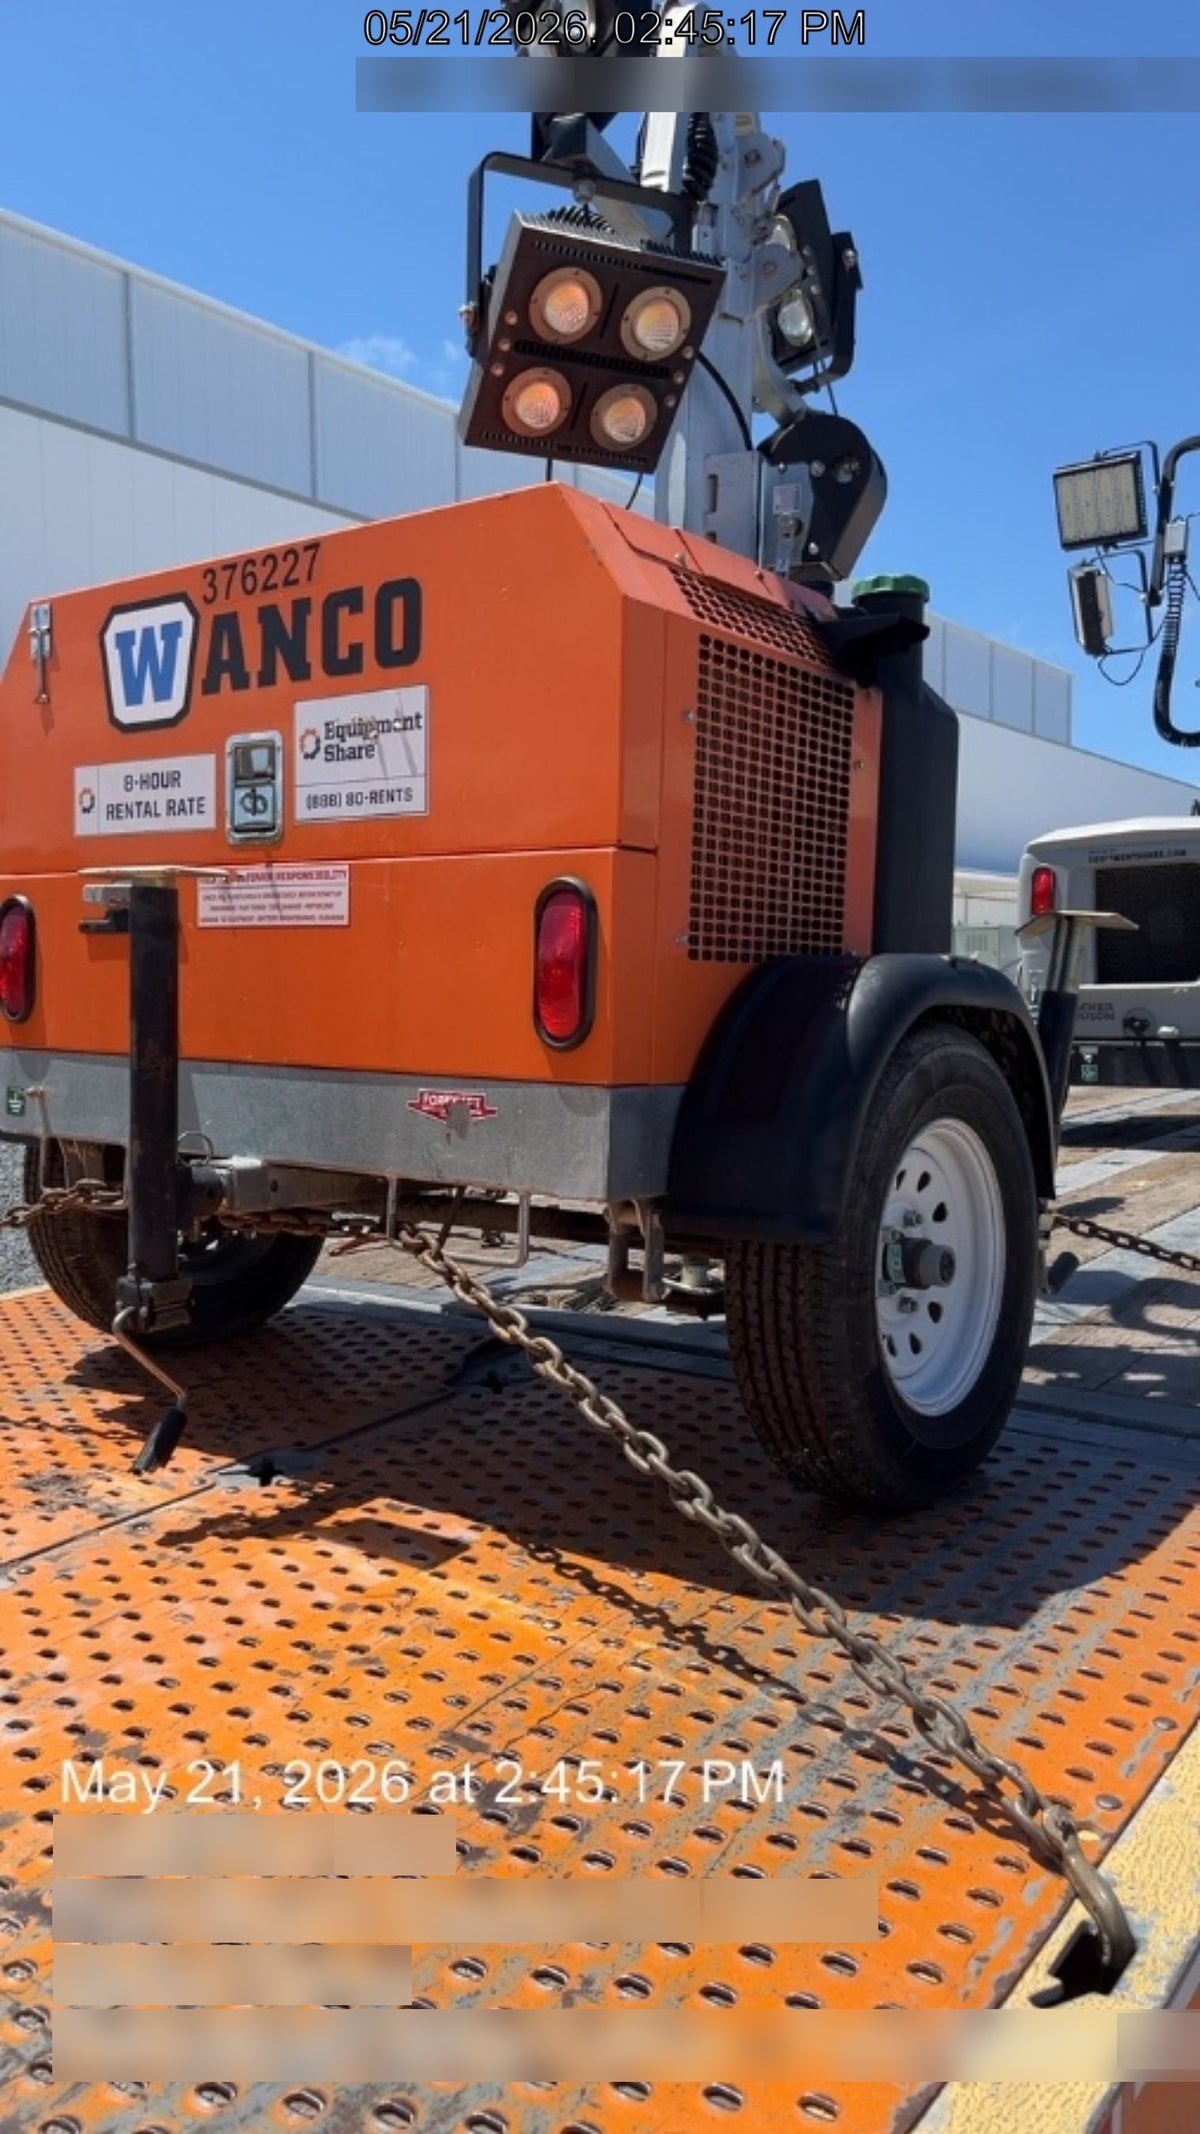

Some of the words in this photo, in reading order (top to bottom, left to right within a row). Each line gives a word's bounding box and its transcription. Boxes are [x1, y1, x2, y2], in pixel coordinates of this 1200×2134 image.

[202, 542, 321, 605] 376227
[114, 576, 423, 708] WANCO
[324, 743, 376, 762] Share
[122, 769, 182, 793] 8-HOUR
[105, 801, 162, 822] RENTAL
[165, 796, 207, 817] RATE
[346, 787, 414, 807] 80-RENTS
